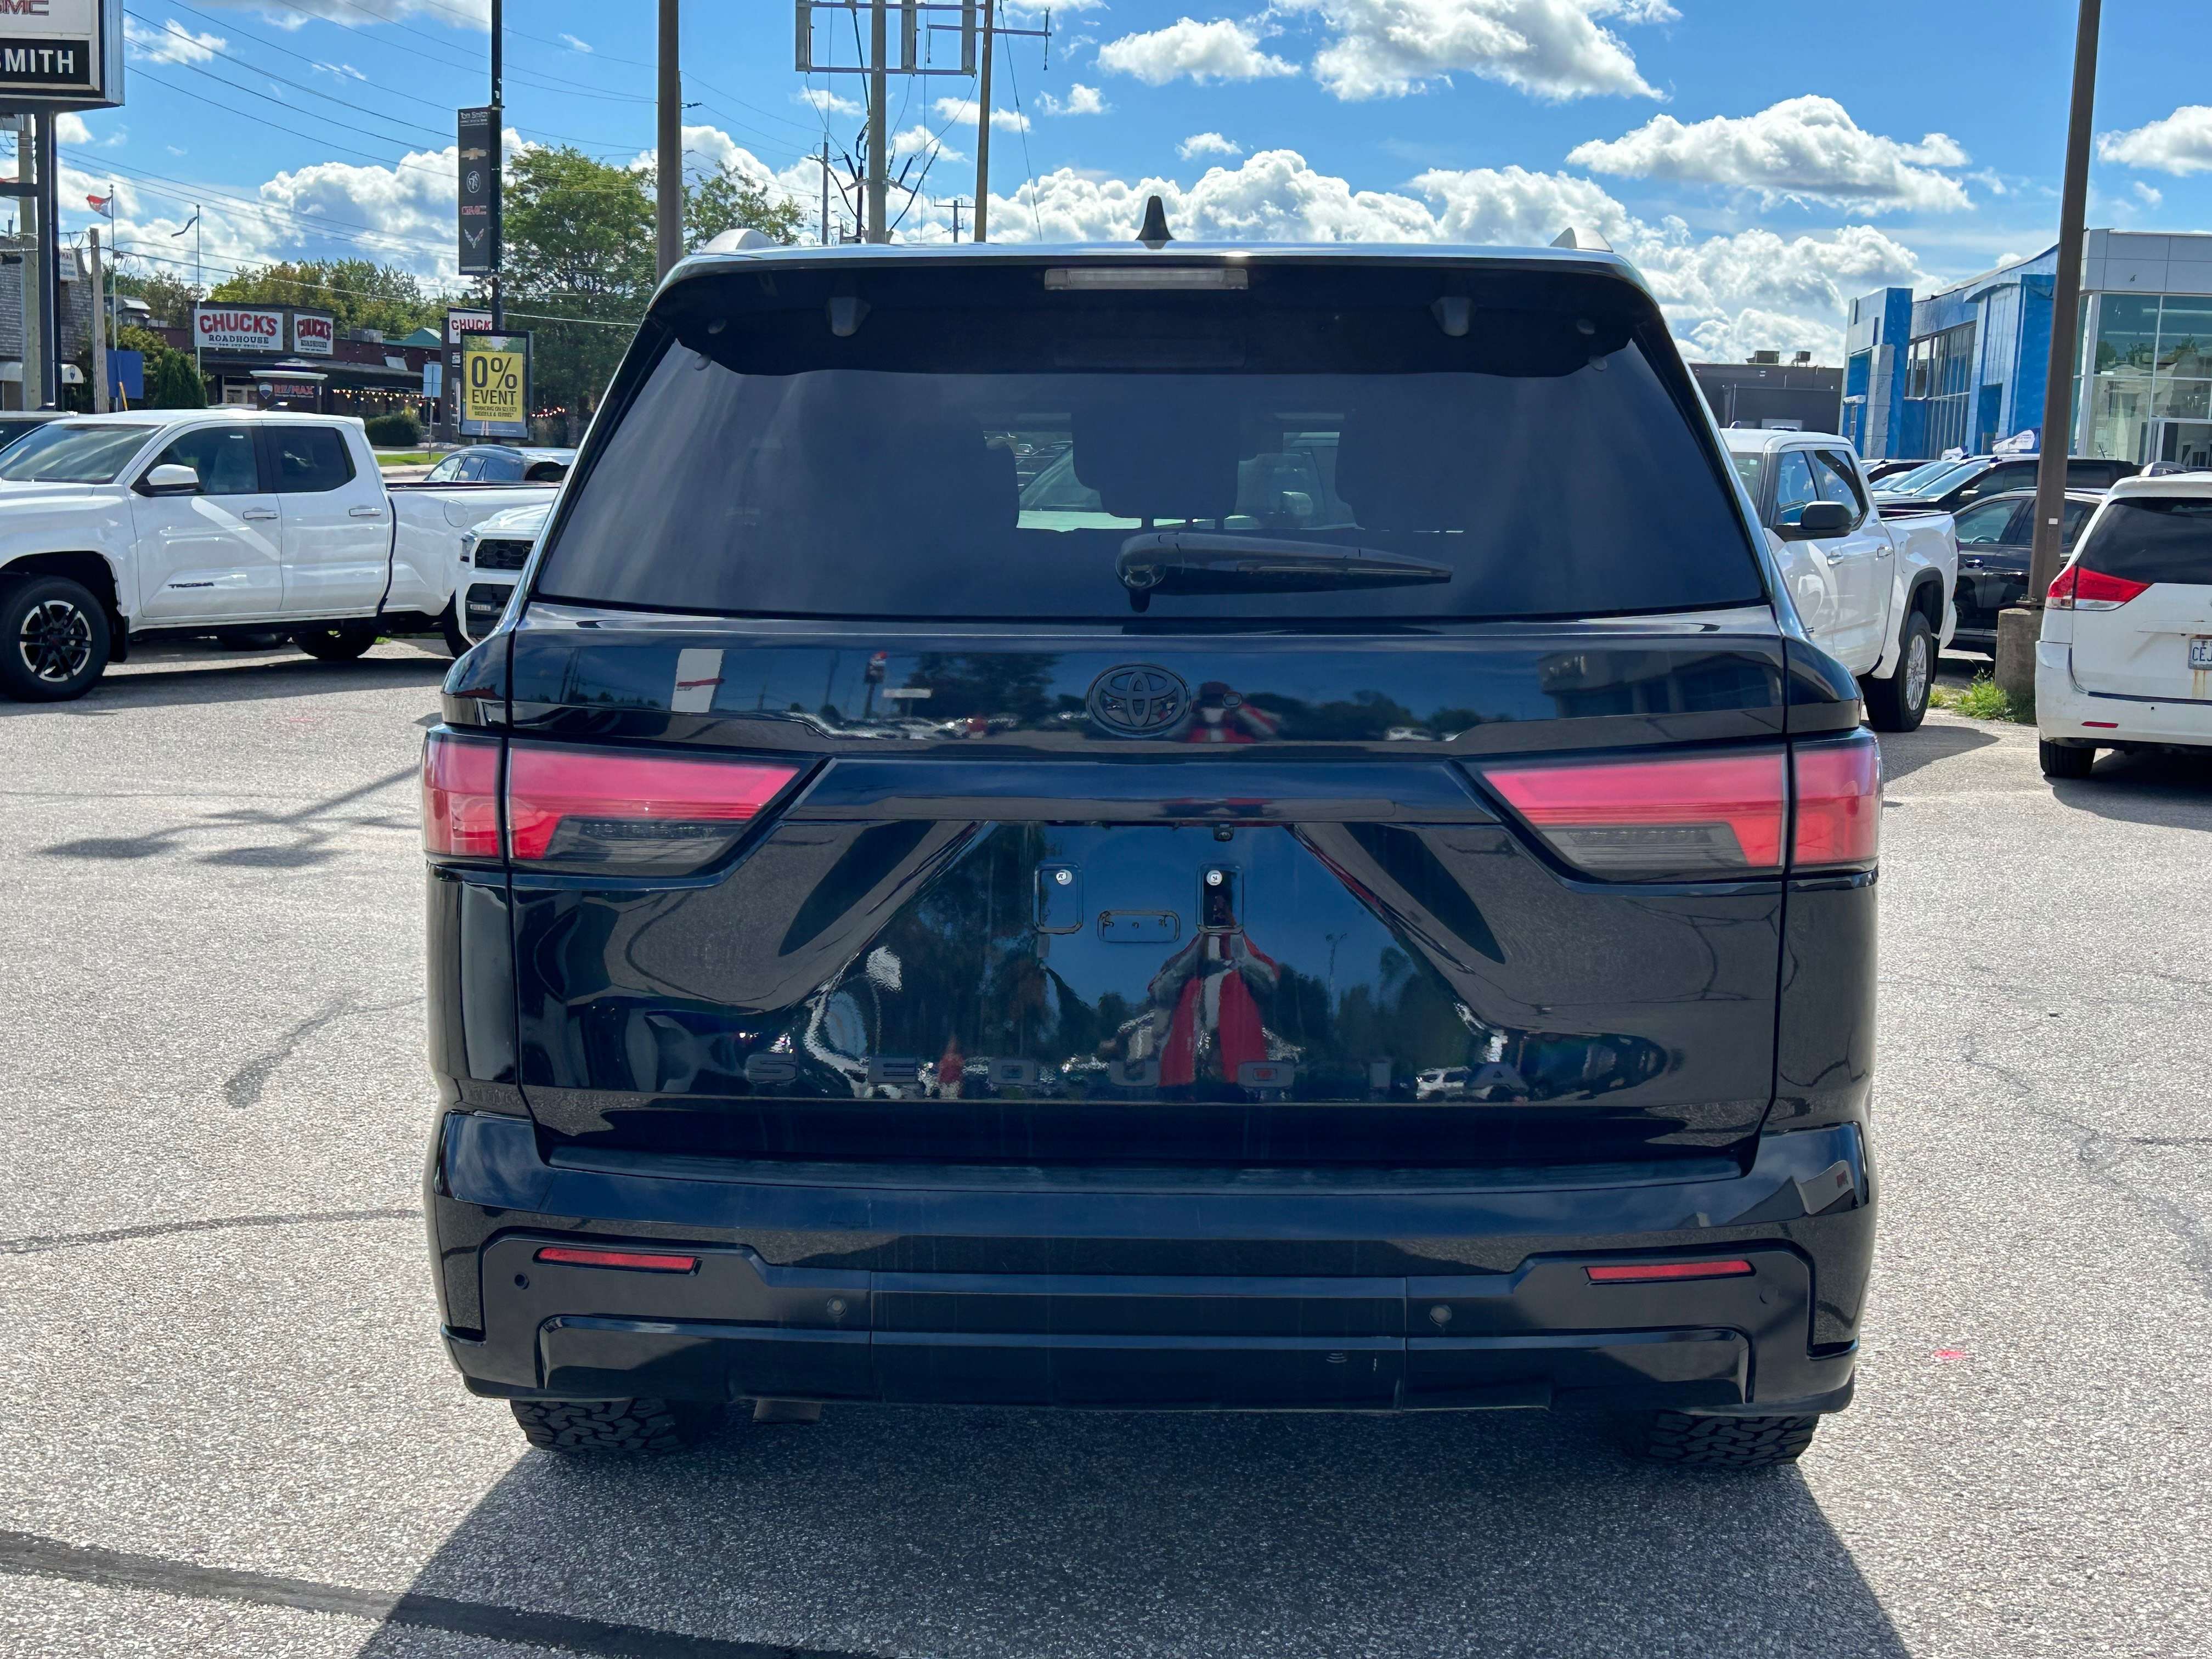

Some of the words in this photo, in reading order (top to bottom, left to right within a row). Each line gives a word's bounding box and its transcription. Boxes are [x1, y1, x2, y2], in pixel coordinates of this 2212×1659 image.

[0, 0, 49, 15] MC
[0, 48, 74, 74] MITH
[200, 313, 278, 336] CHUCK'S
[451, 319, 492, 330] CHUCK
[208, 335, 269, 344] ROADHOUSE
[471, 356, 517, 389] 0%
[472, 389, 517, 405] EVENT
[744, 1052, 1530, 1091] SEQUOIA
